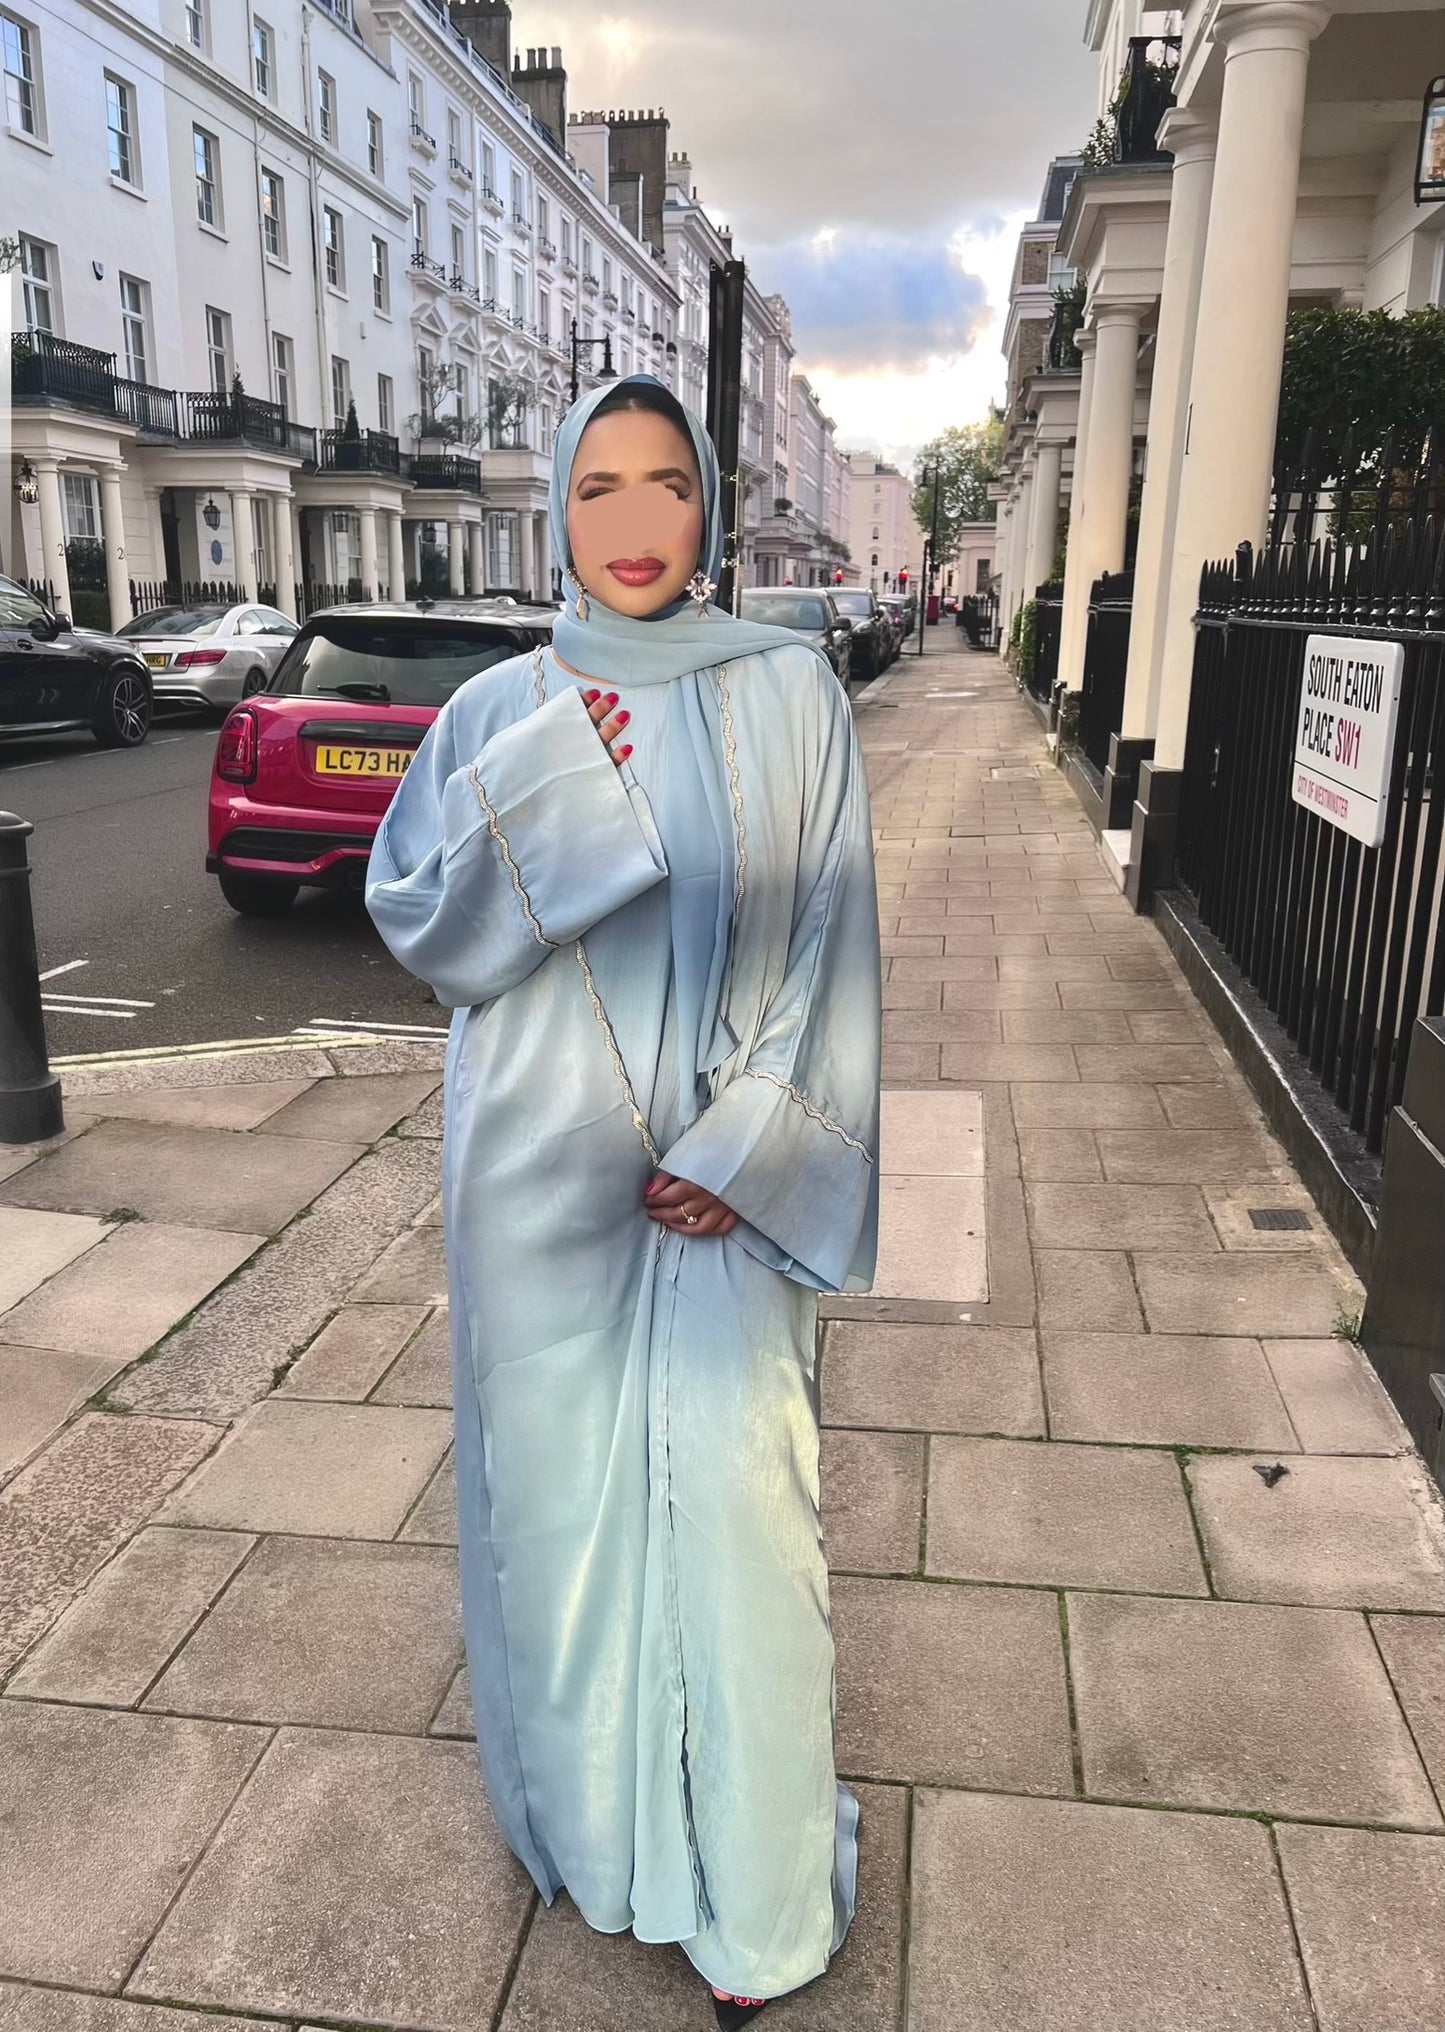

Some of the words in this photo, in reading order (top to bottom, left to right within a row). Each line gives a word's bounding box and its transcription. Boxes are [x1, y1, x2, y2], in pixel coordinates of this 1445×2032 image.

[1307, 654, 1343, 703] SOUTH
[1343, 660, 1384, 714] EATON
[325, 749, 380, 771] LC73
[1302, 707, 1334, 758] PLACE
[1334, 717, 1361, 770] SW1
[1297, 775, 1307, 796] CITY
[1307, 780, 1315, 799] OF
[1314, 784, 1349, 820] WESTMINSTER
